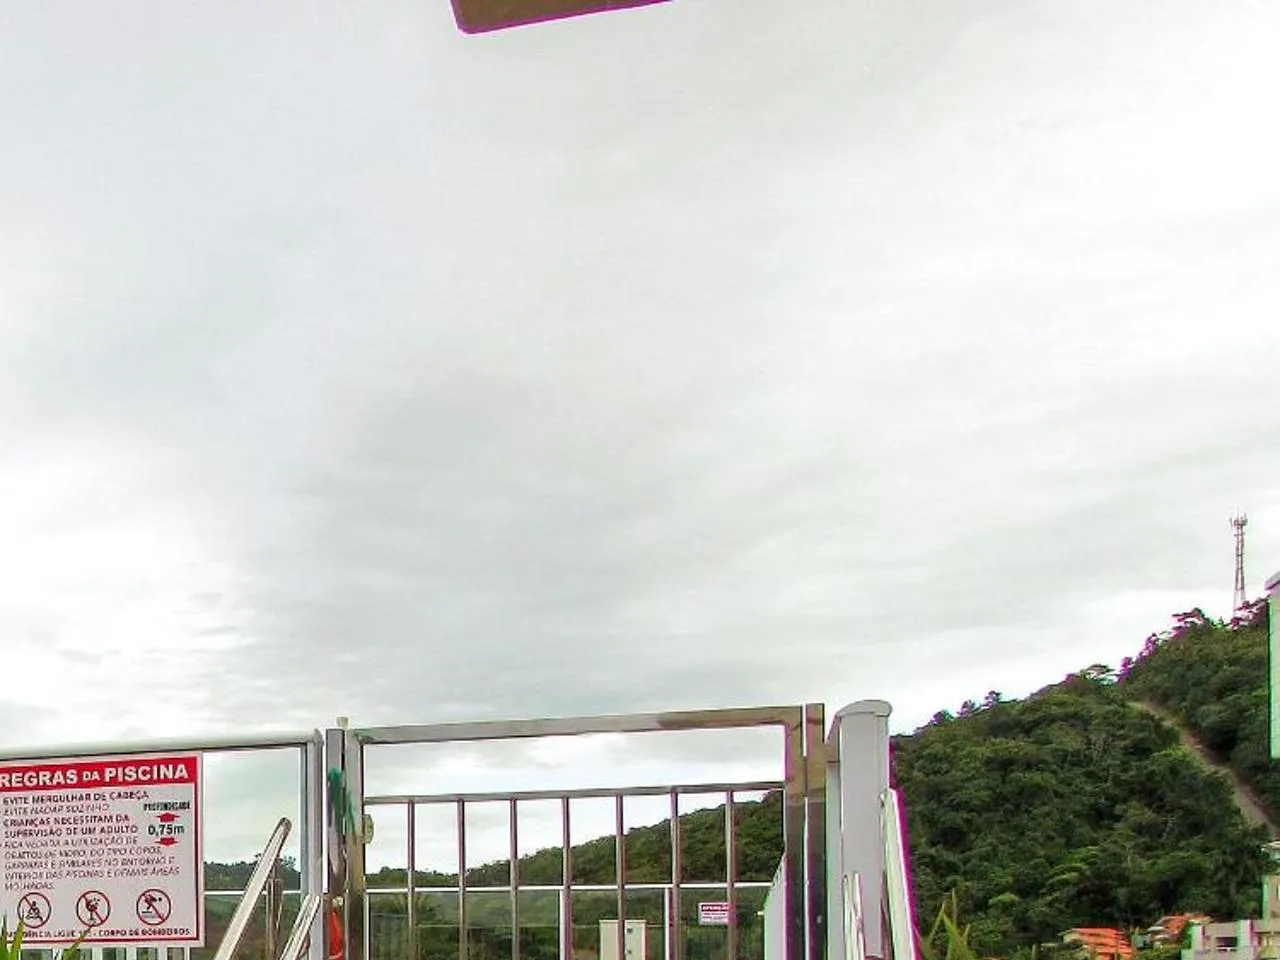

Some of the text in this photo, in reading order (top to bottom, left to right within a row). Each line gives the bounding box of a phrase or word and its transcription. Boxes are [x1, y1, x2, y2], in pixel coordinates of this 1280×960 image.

[82, 770, 100, 781] DA
[104, 763, 189, 783] PISCINA
[2, 790, 149, 805] EVITE MERGULHAR DE CABEÇA
[3, 813, 130, 828] CRIANÇAS NECESSITAM DA
[4, 824, 139, 839] SUPERVISÃO DE UM ADULTO
[147, 824, 185, 837] 0,75m
[98, 928, 127, 937] CORPO
[128, 928, 140, 937] DE
[141, 927, 190, 936] BOMBEIROS
